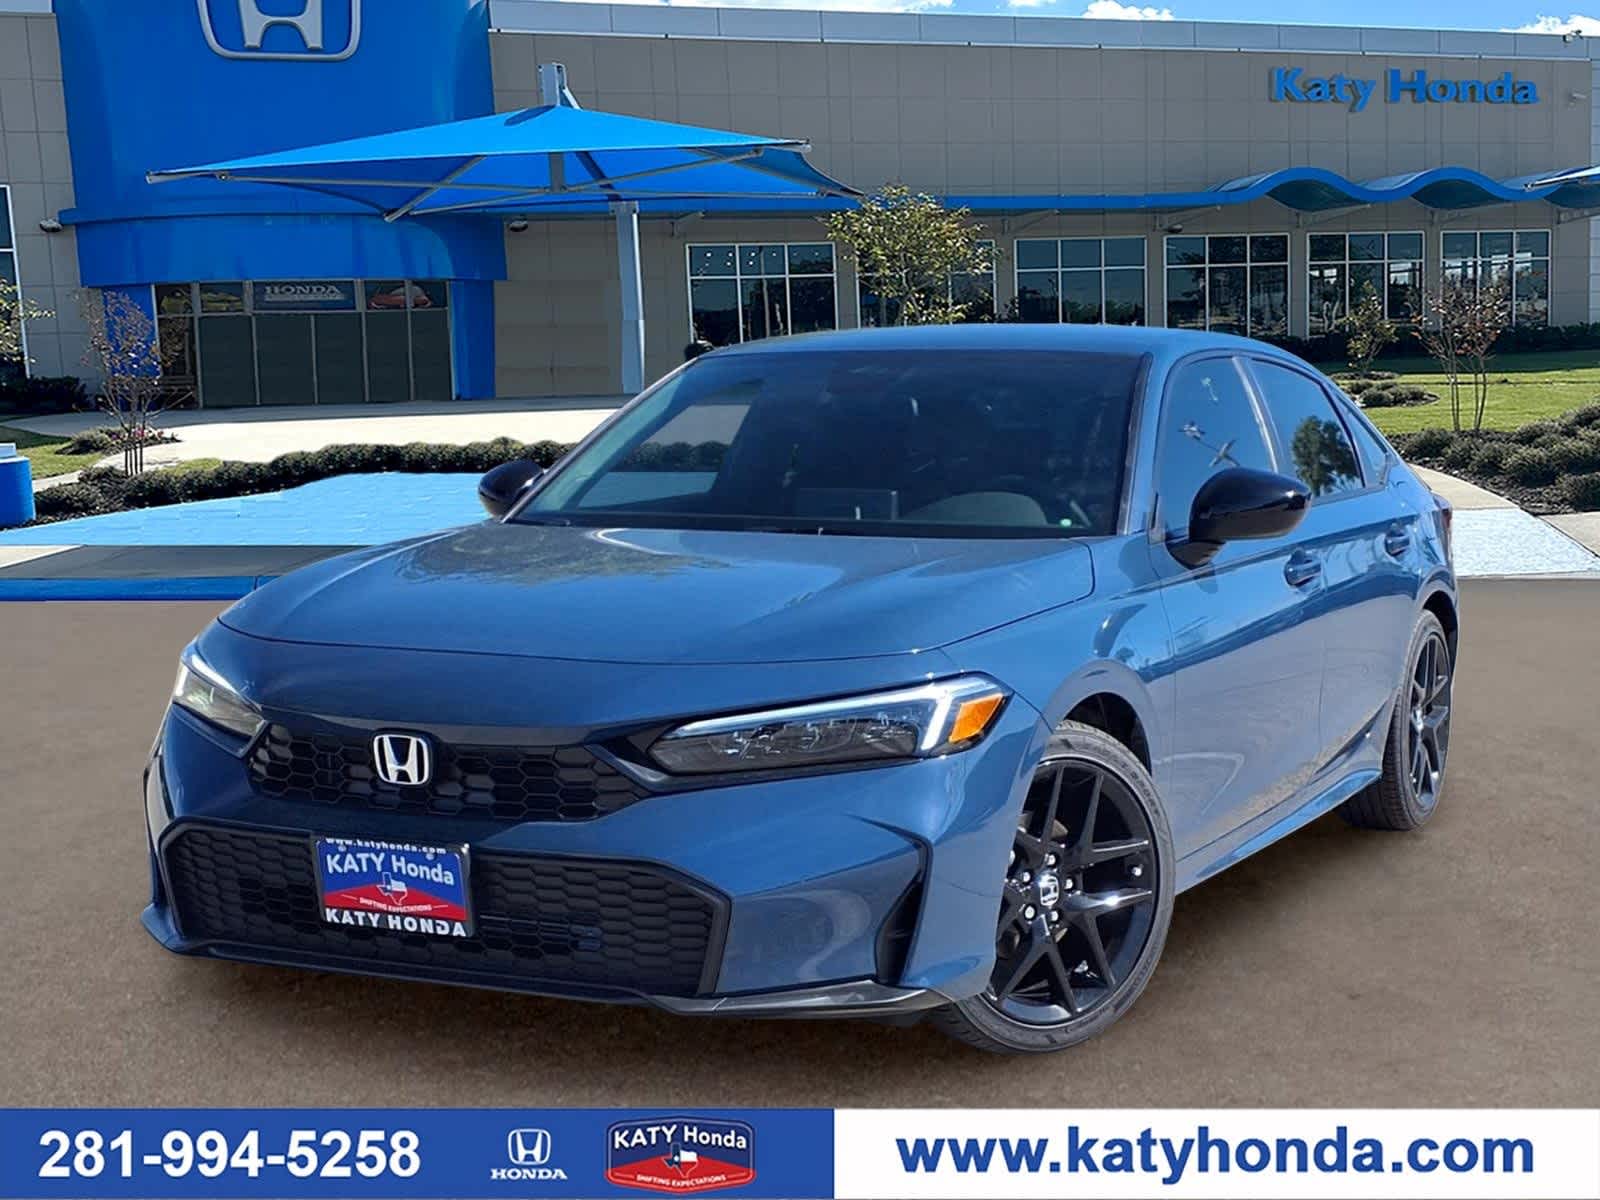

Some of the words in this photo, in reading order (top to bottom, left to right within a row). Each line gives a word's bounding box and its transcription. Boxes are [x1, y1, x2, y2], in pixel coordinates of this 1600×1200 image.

[1272, 67, 1376, 112] Katy
[1386, 68, 1540, 104] Honda
[264, 285, 341, 294] HONDA
[325, 837, 447, 855] www.katyhonda.com
[326, 852, 385, 874] KATY
[391, 854, 454, 886] Honda
[325, 908, 380, 928] KATY
[387, 914, 467, 937] HONDA
